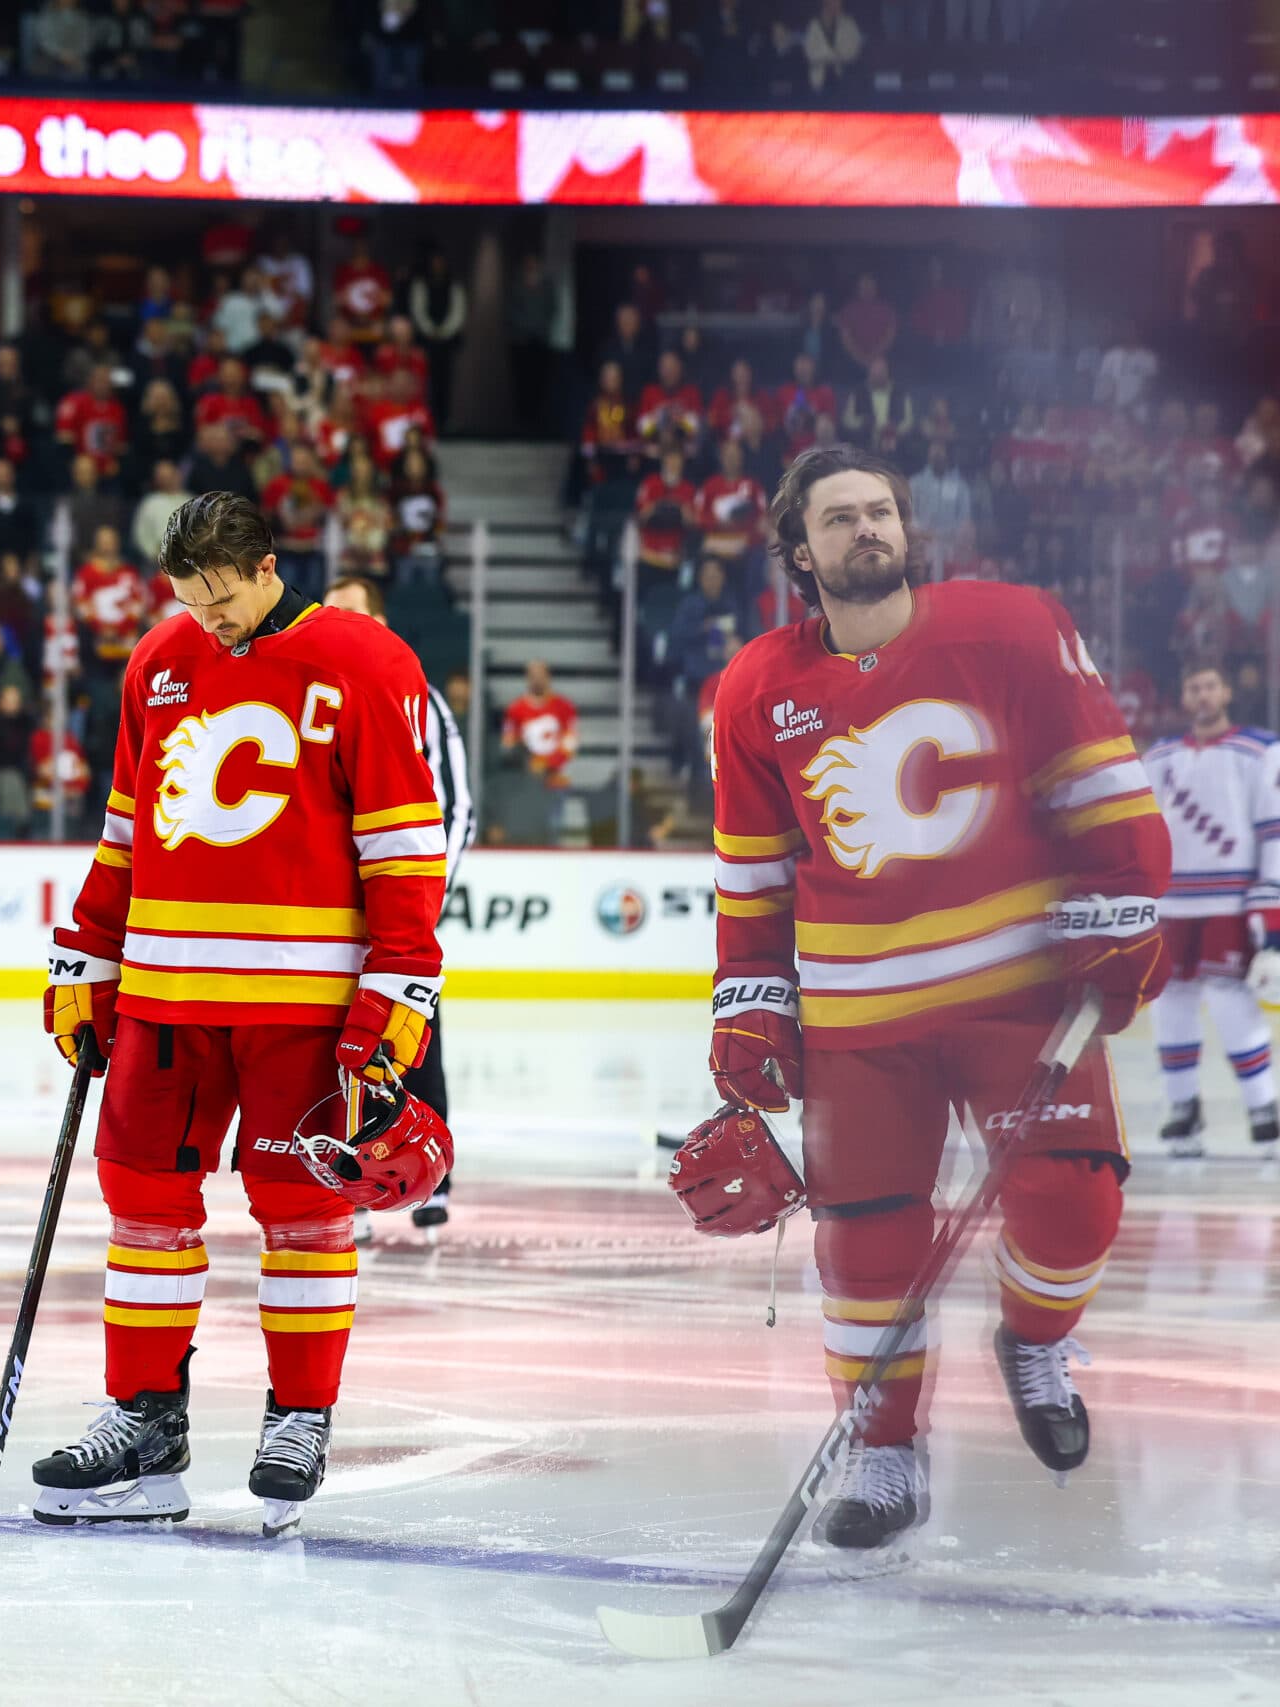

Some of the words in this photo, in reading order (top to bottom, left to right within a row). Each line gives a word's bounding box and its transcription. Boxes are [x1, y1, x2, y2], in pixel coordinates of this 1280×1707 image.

[37, 115, 187, 182] thee
[161, 681, 189, 695] play
[147, 693, 188, 707] alberta
[300, 681, 343, 744] C
[789, 708, 819, 728] play
[775, 720, 823, 742] alberta
[341, 1043, 364, 1053] CCM
[423, 1137, 442, 1163] 11
